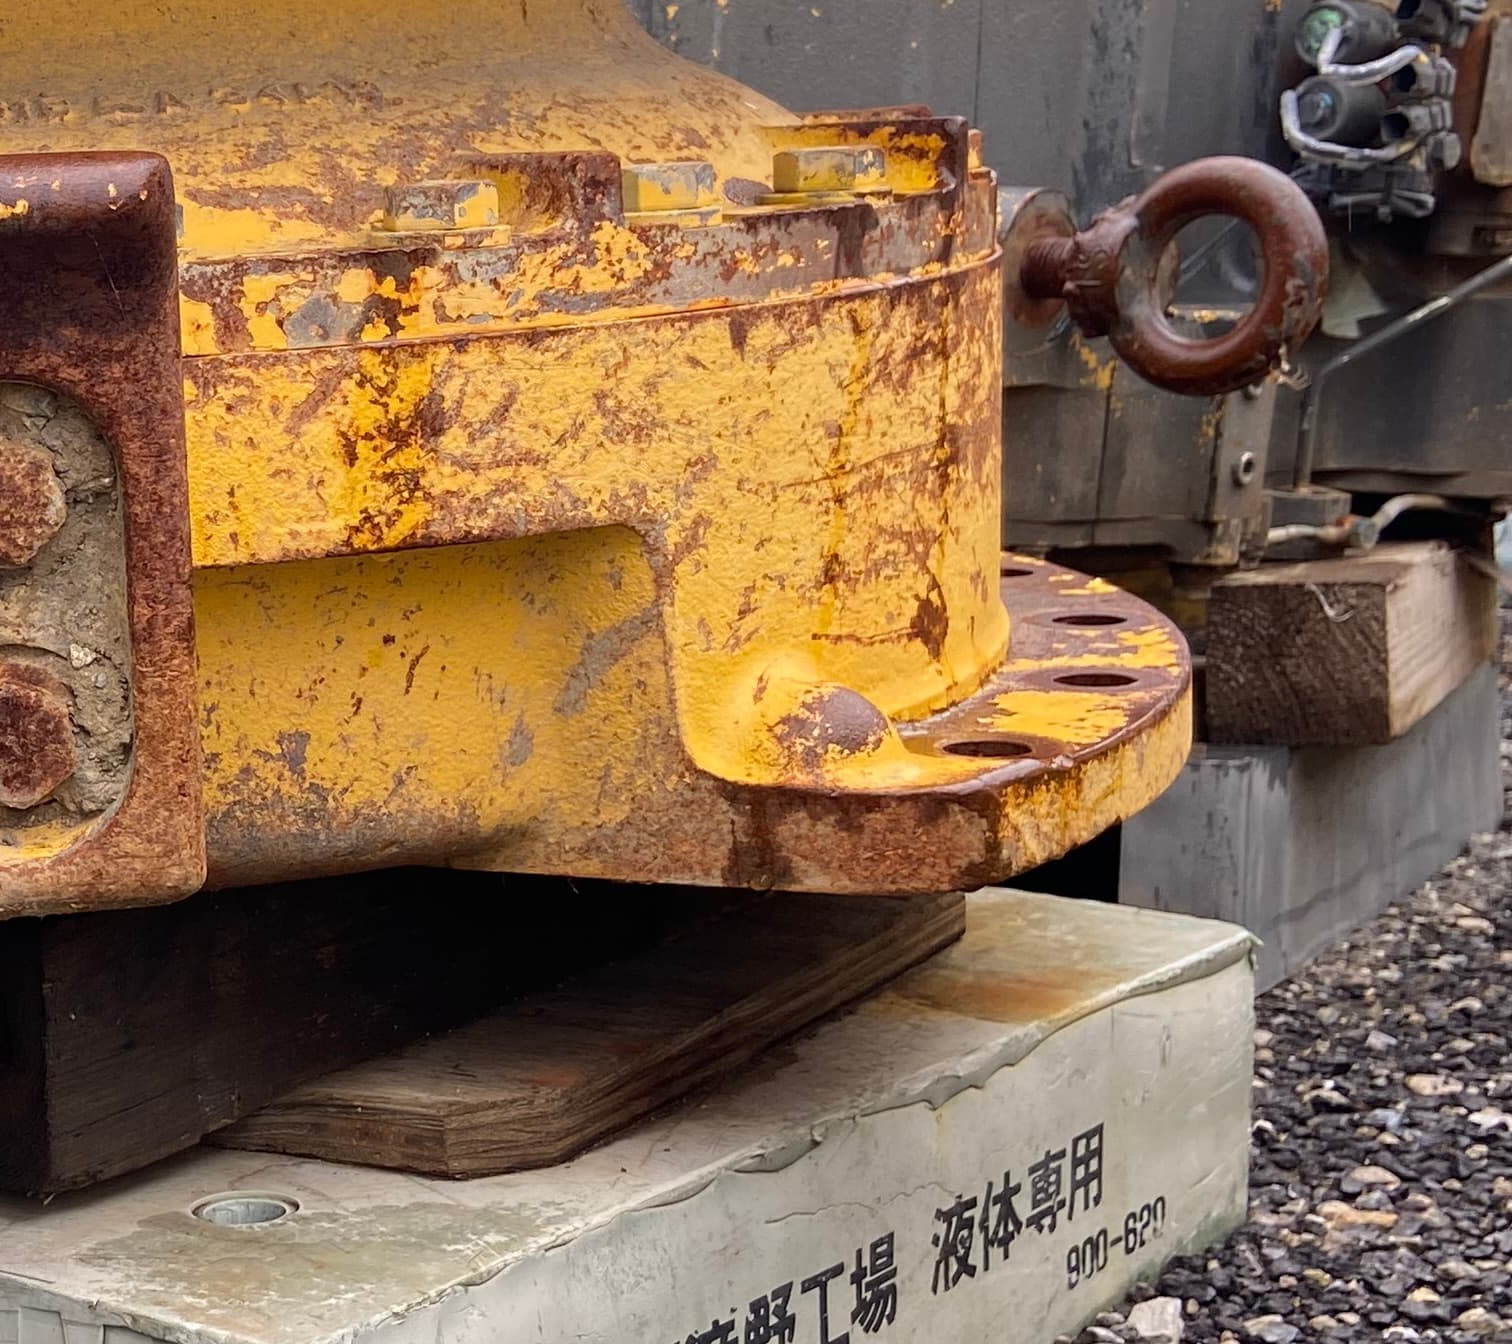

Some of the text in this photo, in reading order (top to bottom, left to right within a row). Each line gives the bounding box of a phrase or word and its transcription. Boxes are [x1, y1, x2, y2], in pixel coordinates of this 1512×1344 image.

[930, 1122, 1105, 1295] 液体専用
[1067, 1196, 1166, 1290] 900-620
